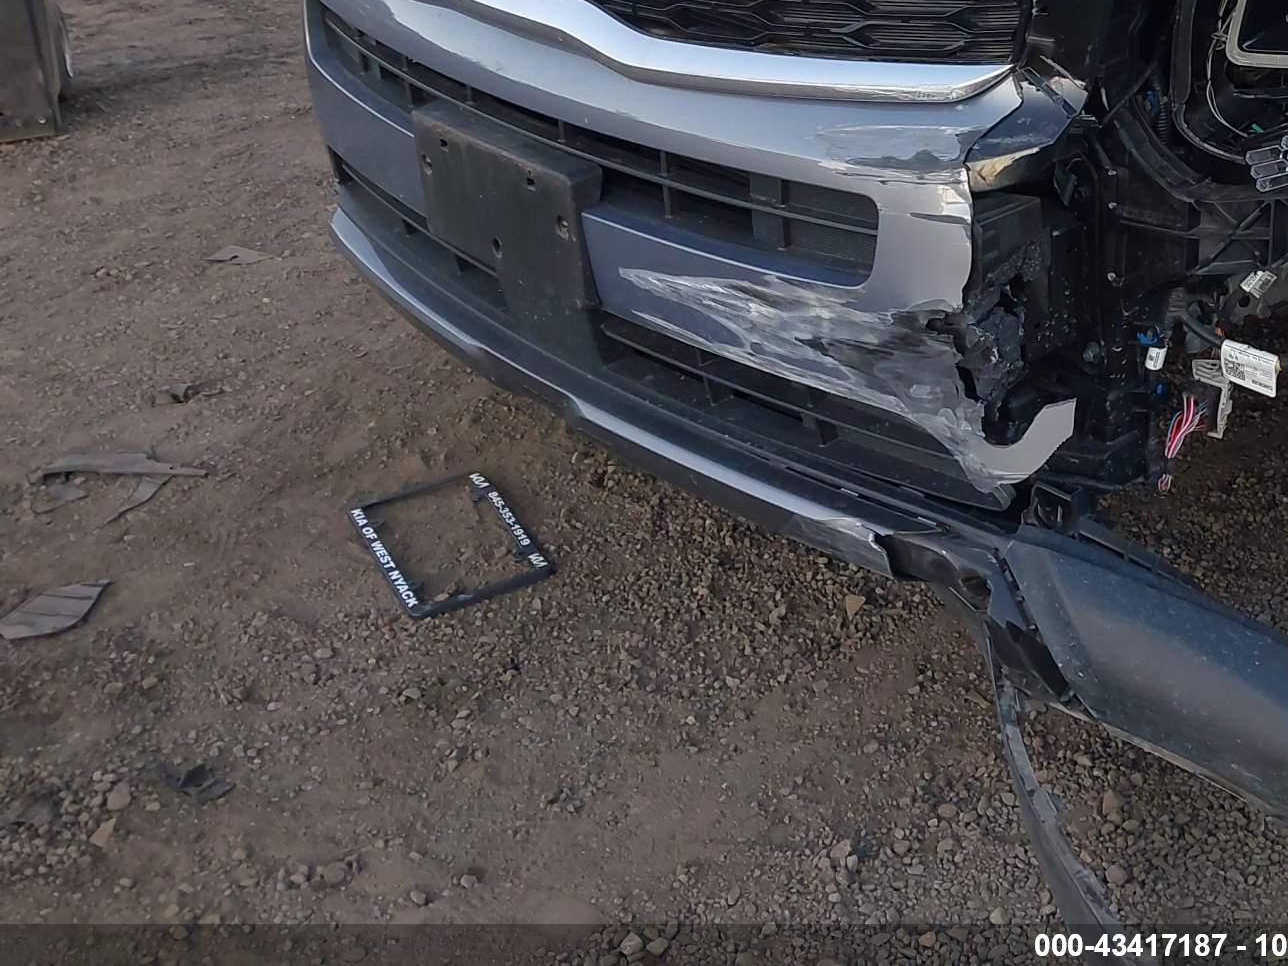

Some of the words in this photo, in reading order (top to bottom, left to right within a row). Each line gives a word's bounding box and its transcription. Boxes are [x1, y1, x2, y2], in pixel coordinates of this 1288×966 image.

[487, 490, 531, 547] 845-353-1919
[350, 508, 369, 527] KIA
[361, 526, 378, 541] OF
[370, 540, 396, 570] WEST
[388, 569, 419, 609] NYACK
